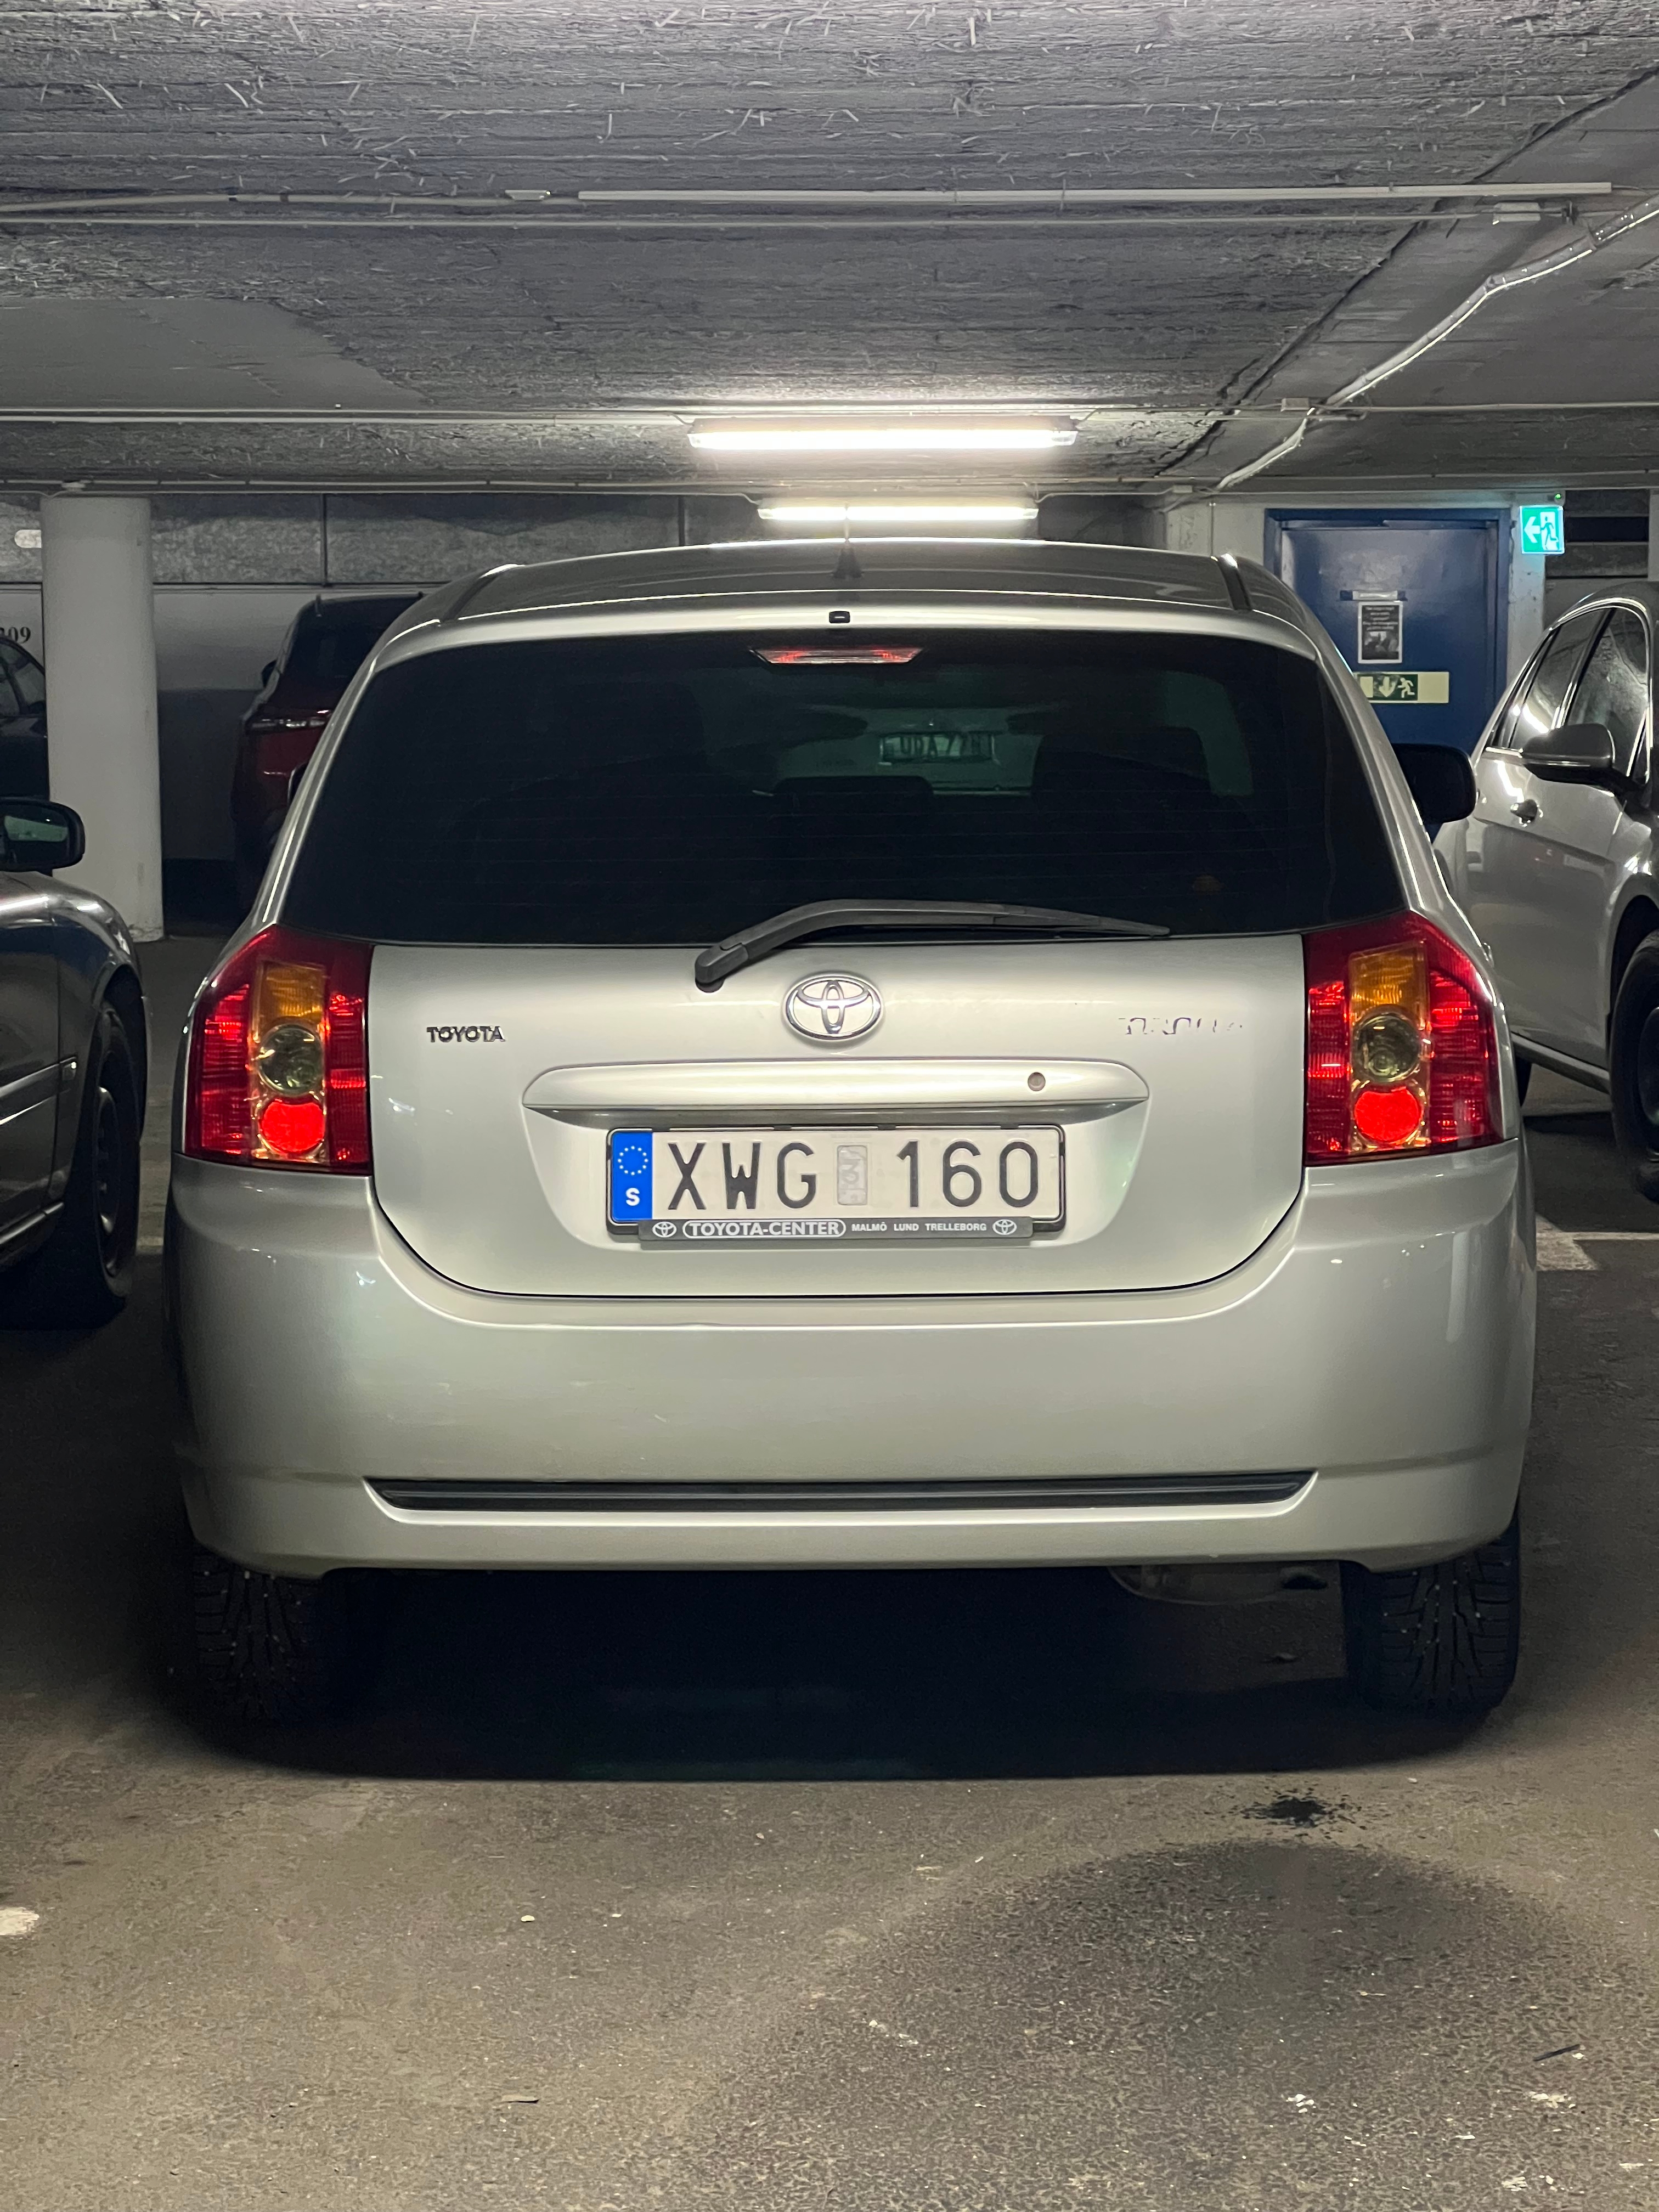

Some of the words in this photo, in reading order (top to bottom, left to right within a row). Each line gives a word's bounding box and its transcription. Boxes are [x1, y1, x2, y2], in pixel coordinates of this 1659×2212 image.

[426, 1025, 506, 1043] TOYOTA
[667, 1141, 817, 1210] XWG
[896, 1138, 1039, 1209] 160
[625, 1187, 640, 1206] S
[689, 1221, 840, 1236] TOYOTA-CENTER
[851, 1221, 887, 1232] MALMÖ
[893, 1223, 919, 1231] LUND
[924, 1223, 987, 1231] TRELLEBORG
